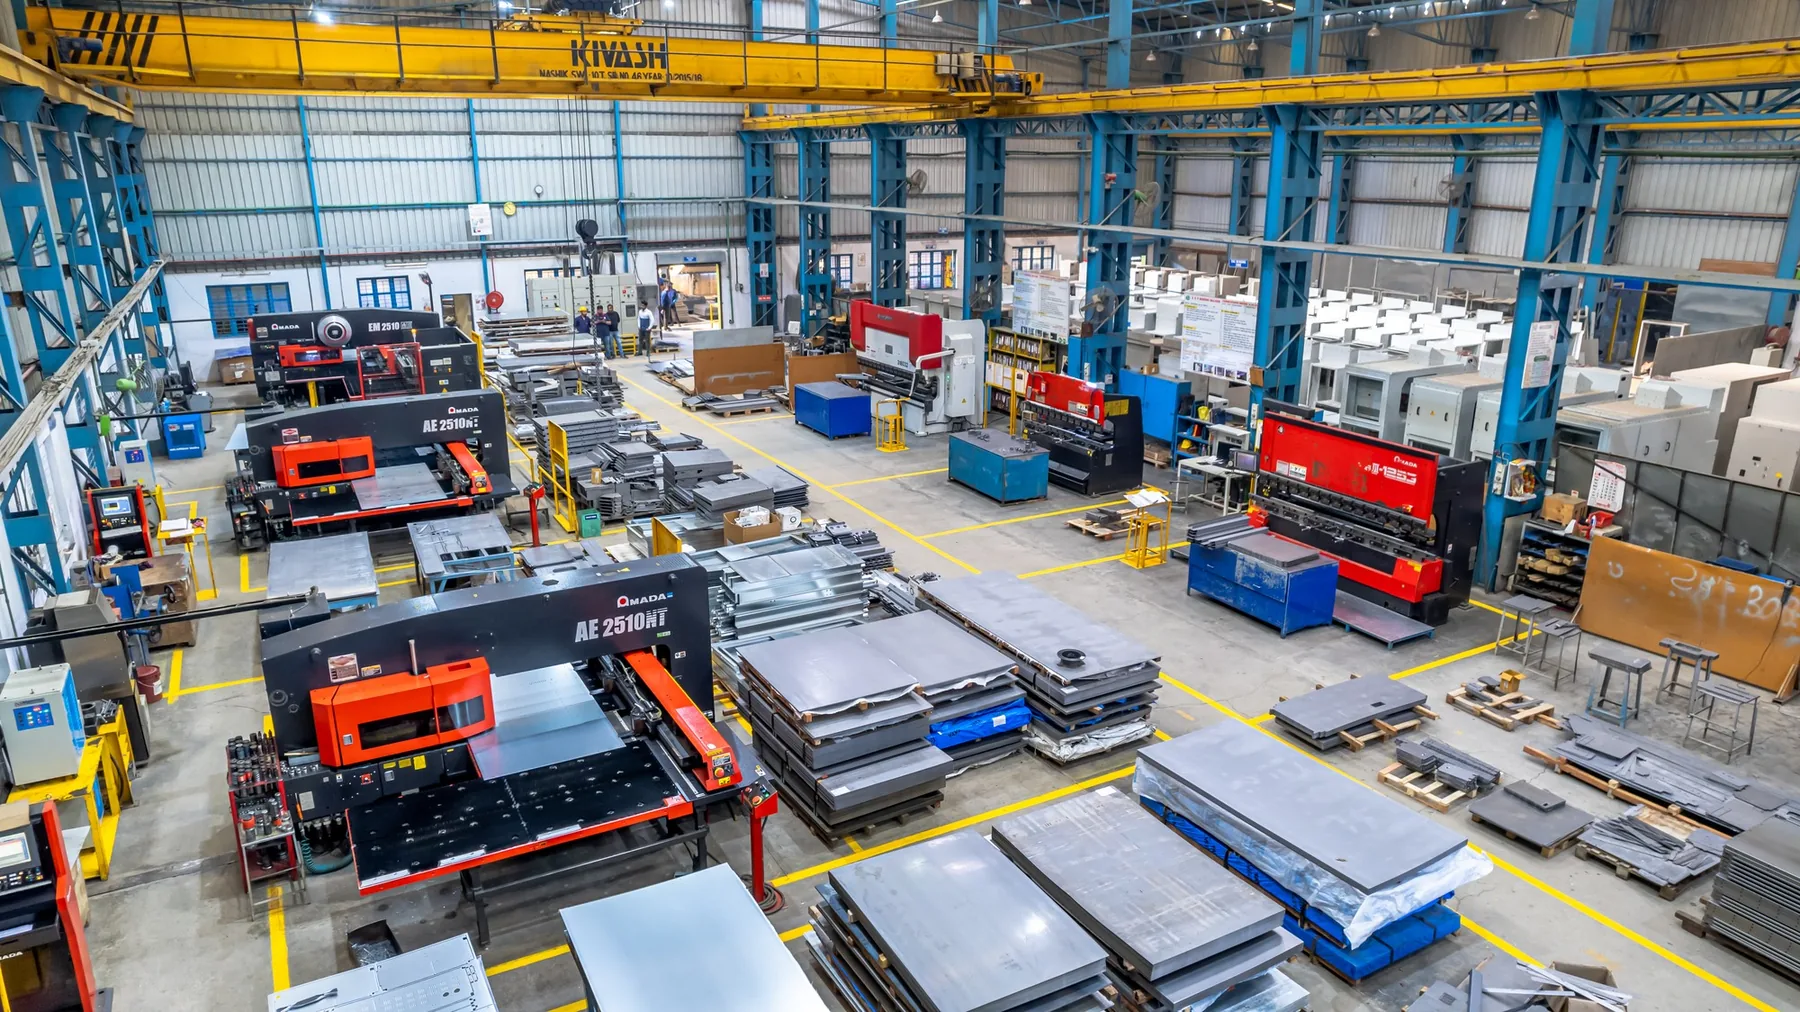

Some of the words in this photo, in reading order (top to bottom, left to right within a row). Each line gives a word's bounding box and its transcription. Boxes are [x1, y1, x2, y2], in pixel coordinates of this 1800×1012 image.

[570, 39, 667, 69] KIVASH
[368, 322, 381, 332] EM
[381, 321, 400, 331] 2510
[448, 406, 479, 414] AMADA
[423, 419, 438, 433] AE
[617, 593, 667, 608] AMADA
[574, 618, 599, 643] AE
[0, 951, 24, 961] ADA
